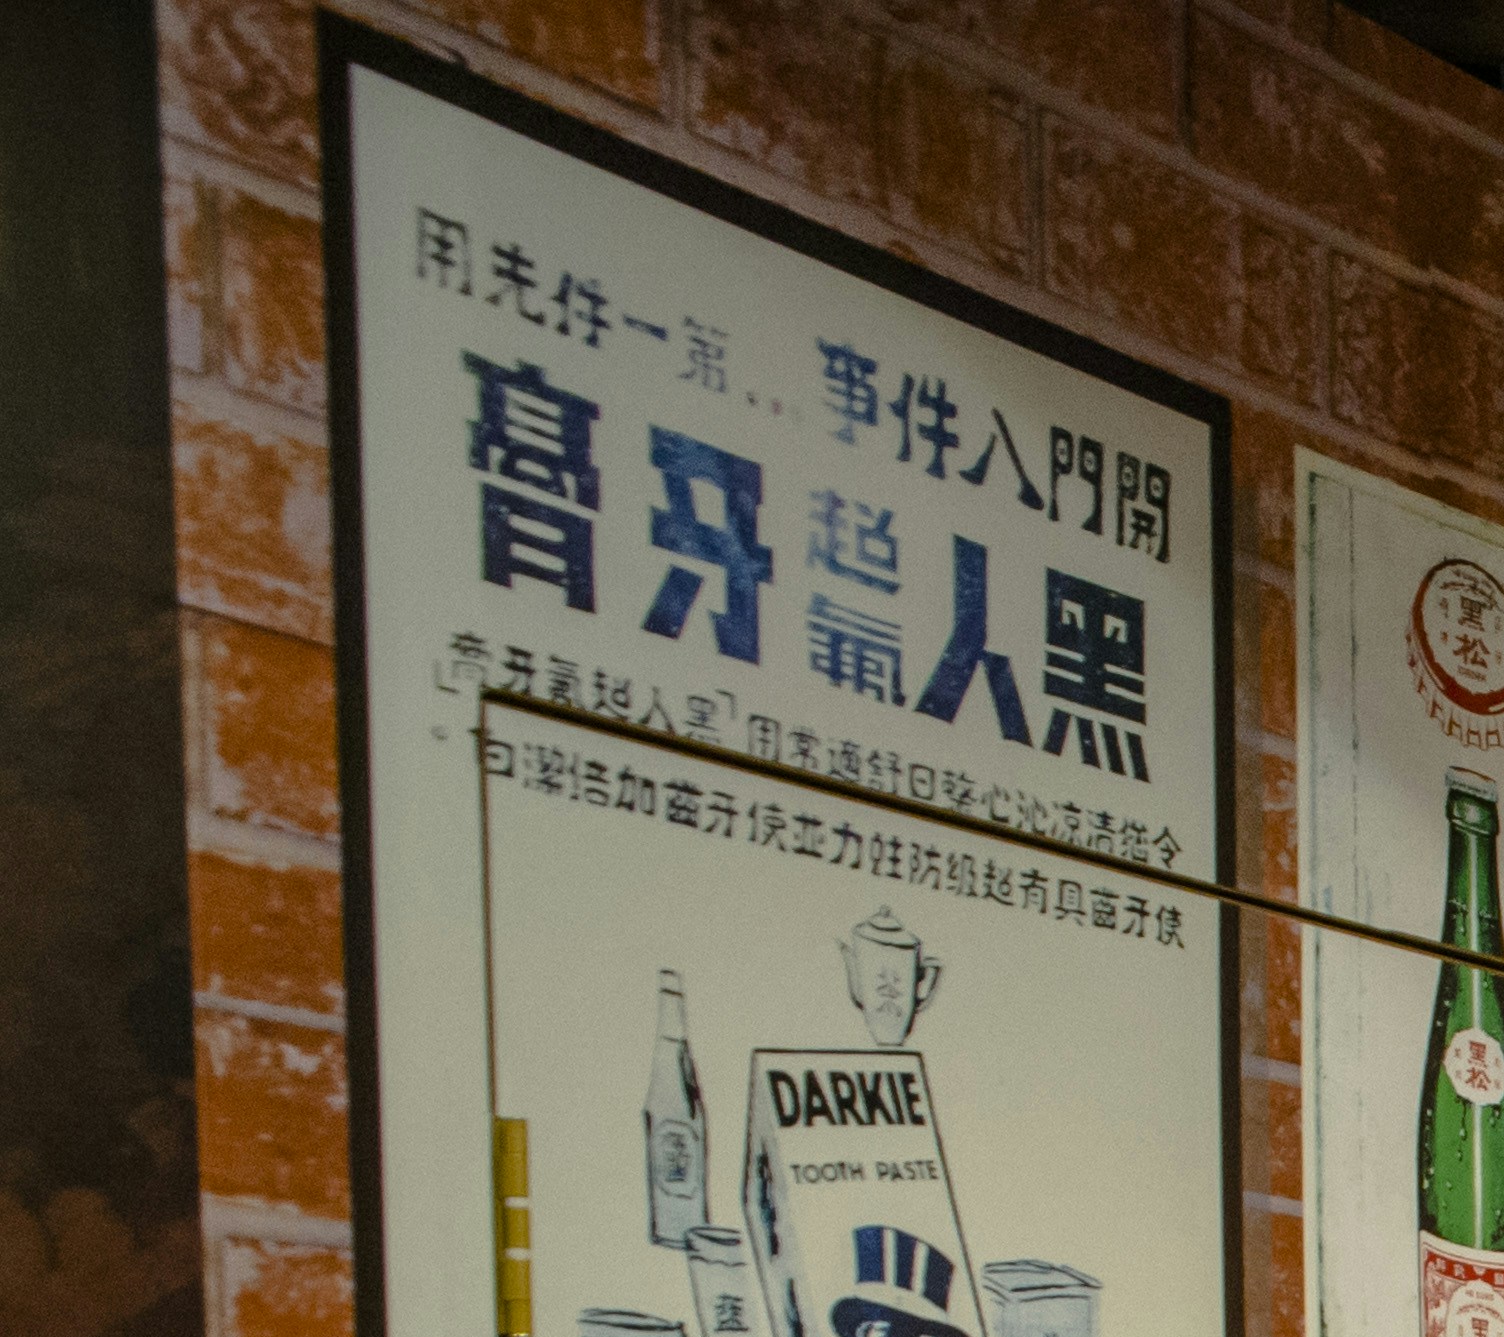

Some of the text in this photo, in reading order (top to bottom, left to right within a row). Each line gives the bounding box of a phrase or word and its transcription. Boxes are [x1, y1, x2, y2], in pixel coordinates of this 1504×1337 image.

[766, 1069, 928, 1127] DARKIE
[790, 1159, 940, 1184] TOOTH PASTE
